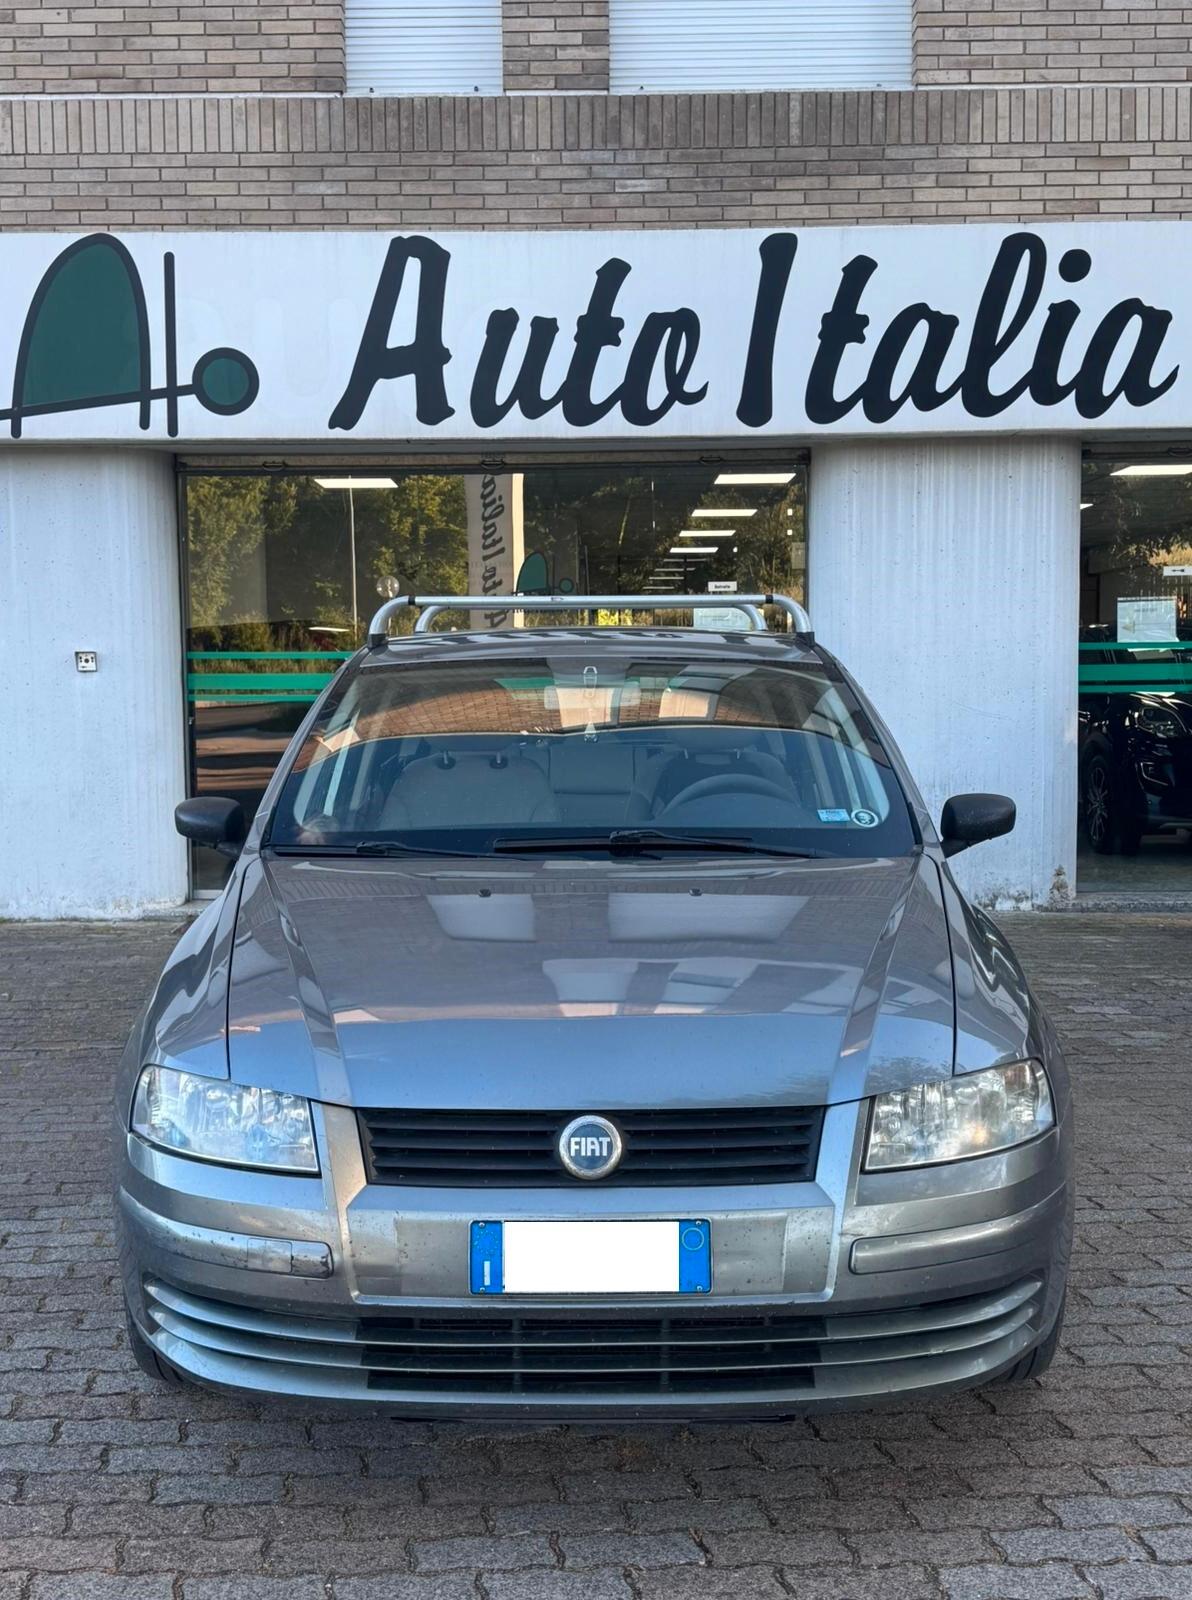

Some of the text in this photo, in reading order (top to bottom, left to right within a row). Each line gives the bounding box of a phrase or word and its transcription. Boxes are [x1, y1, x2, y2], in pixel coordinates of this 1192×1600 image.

[328, 232, 1179, 430] Auto Italia
[570, 1136, 611, 1157] FIAT
[483, 1260, 491, 1286] I
